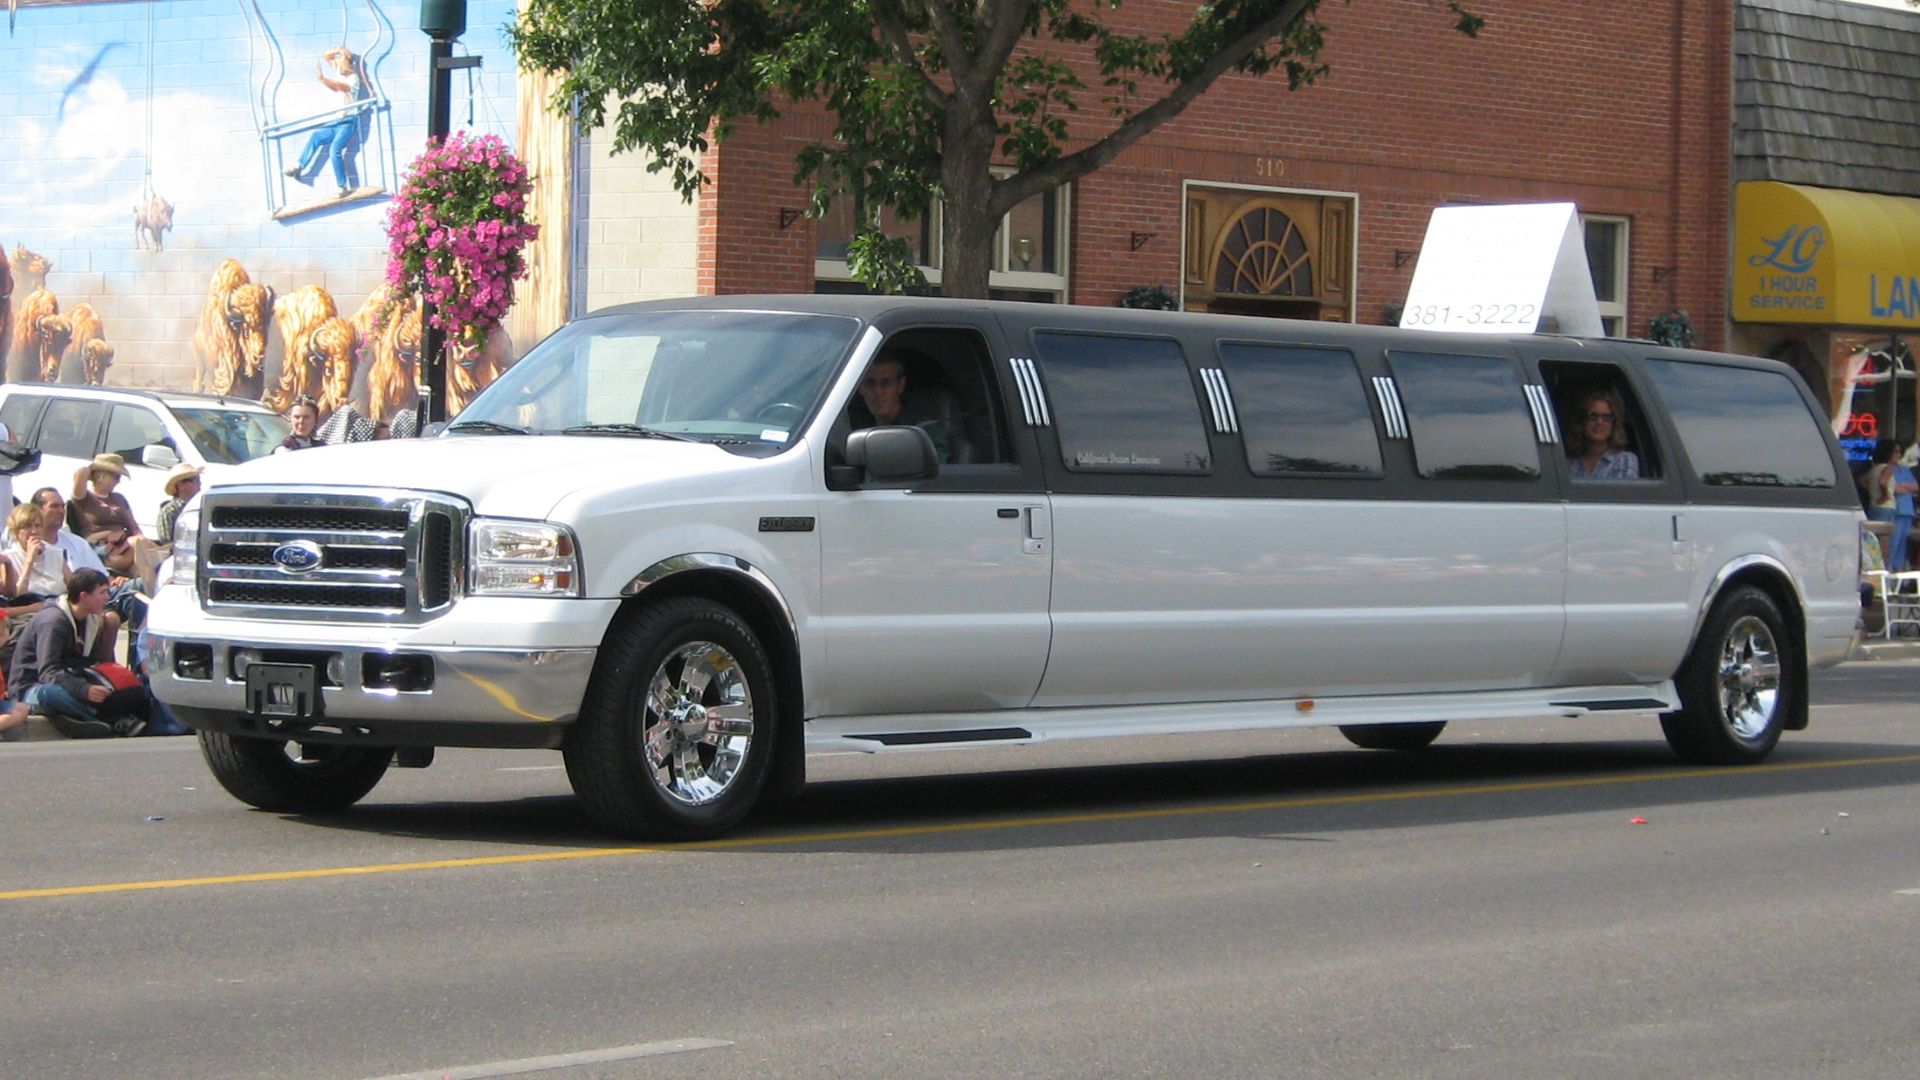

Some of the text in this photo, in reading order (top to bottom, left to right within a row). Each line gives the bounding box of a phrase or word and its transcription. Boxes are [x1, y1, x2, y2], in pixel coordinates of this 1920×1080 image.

[1256, 158, 1285, 176] 510
[1760, 275, 1817, 292] 1 HOUR
[1749, 295, 1825, 309] SERVICE
[1406, 303, 1536, 326] 381-3222
